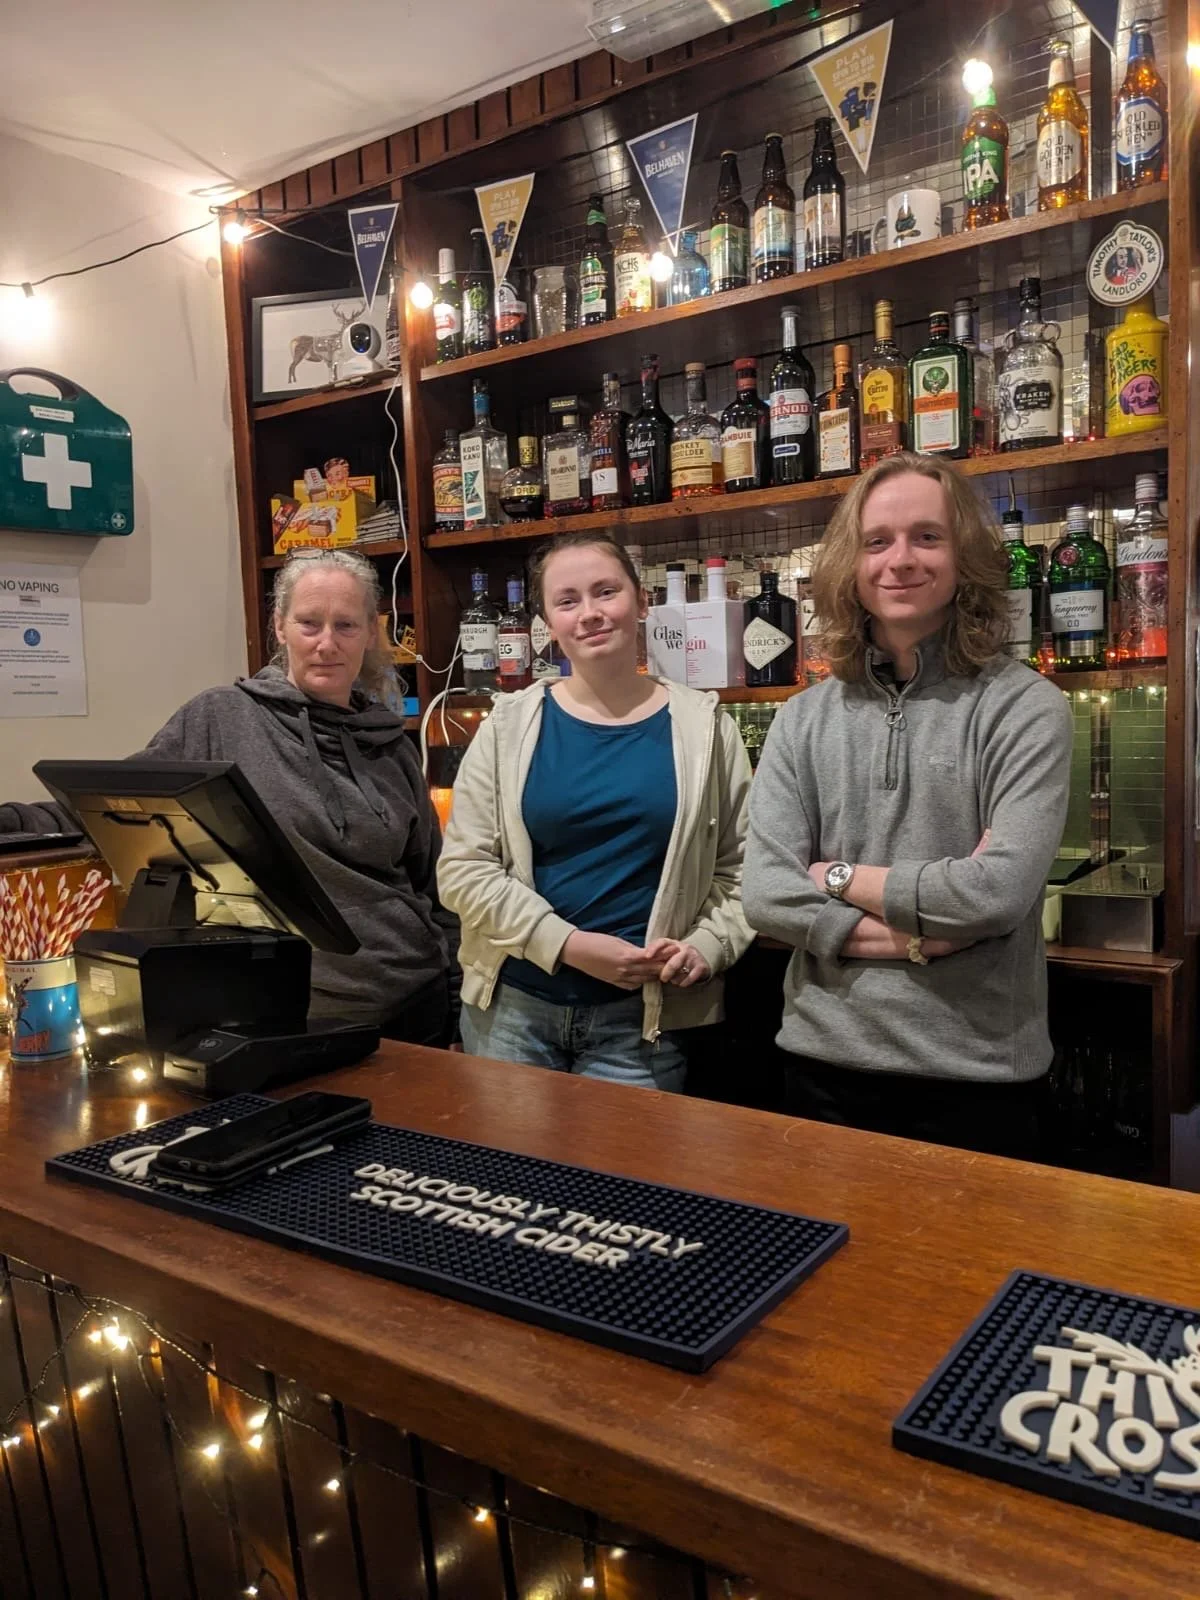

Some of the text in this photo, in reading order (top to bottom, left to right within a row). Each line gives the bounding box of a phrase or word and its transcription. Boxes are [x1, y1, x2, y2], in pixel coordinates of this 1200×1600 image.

[836, 45, 867, 70] PLAY
[1127, 111, 1146, 124] OLD
[1045, 135, 1063, 148] OD
[982, 150, 997, 158] KING
[645, 152, 685, 178] BELHAVEN
[964, 158, 999, 195] IPA
[494, 189, 516, 200] PLAY
[357, 231, 386, 245] BELHAVEN
[1092, 231, 1157, 279] TIMOTHY TAYLOR'S
[1101, 271, 1148, 296] LANDLORD
[1016, 391, 1050, 400] KRAKEN
[633, 432, 655, 450] Maria
[463, 444, 481, 454] KOKO
[463, 452, 481, 461] KANU
[280, 537, 335, 550] CARAMEL
[1118, 545, 1168, 562] Gordon's
[0, 579, 60, 594] NO VAPING
[1053, 604, 1097, 618] Tanqueray
[465, 634, 475, 642] GIN
[653, 626, 683, 641] Glas
[500, 643, 513, 655] EG
[666, 636, 707, 653] we gin
[353, 1163, 703, 1260] DELICIOUSLY THISTLY
[350, 1186, 630, 1269] SCOTTISH CIDER
